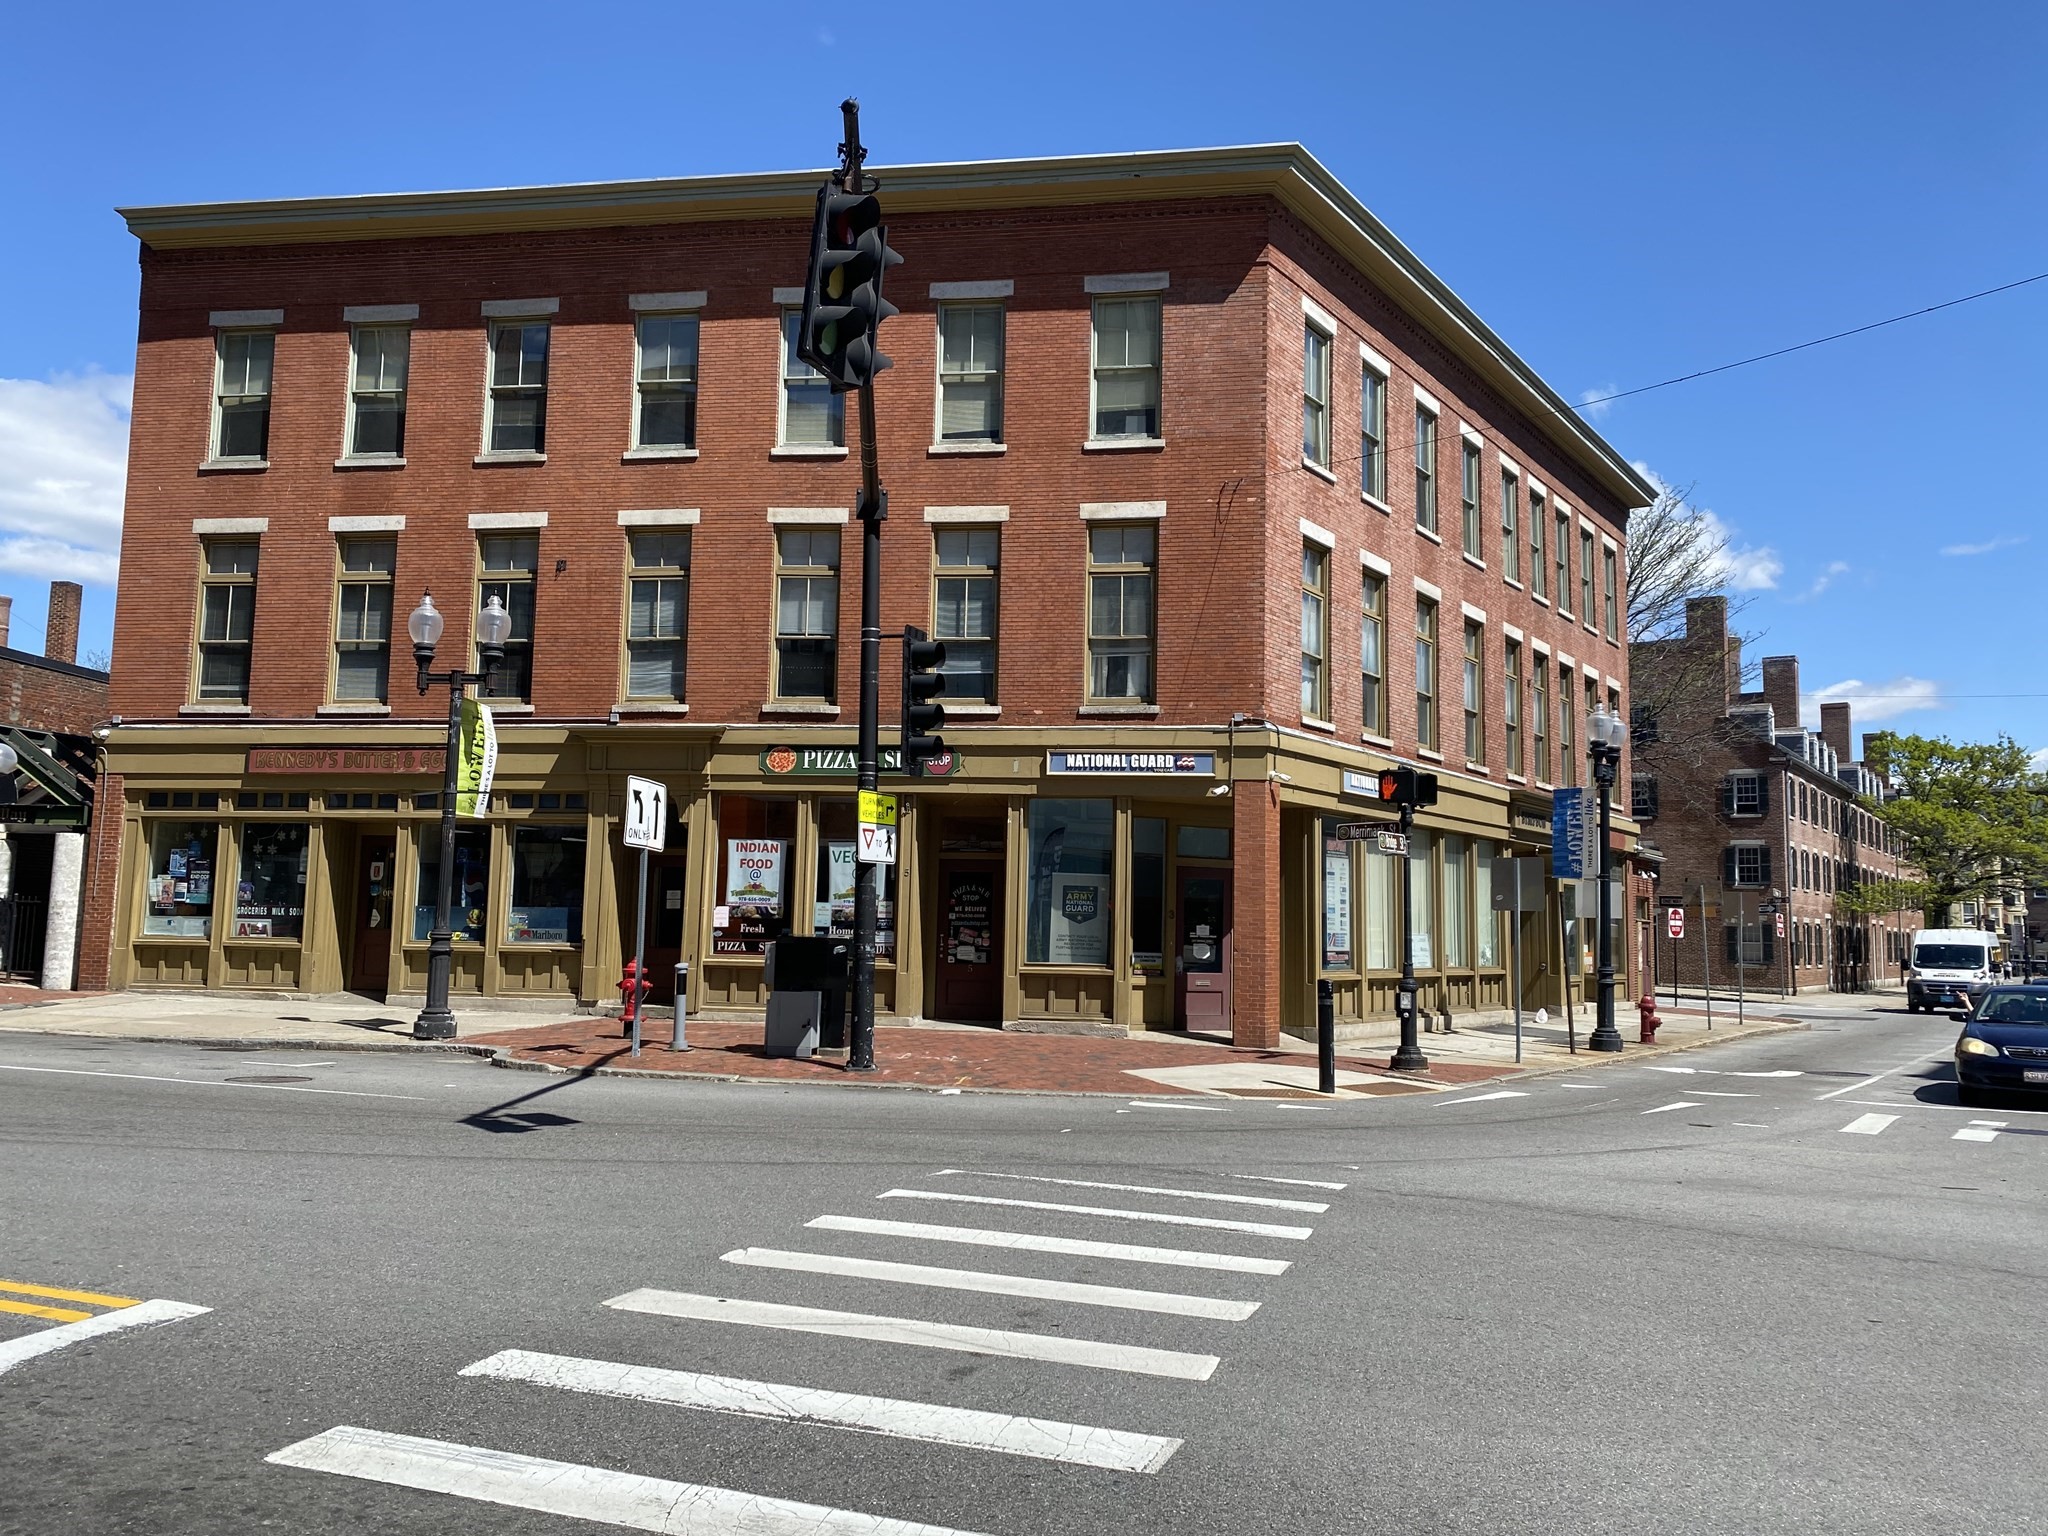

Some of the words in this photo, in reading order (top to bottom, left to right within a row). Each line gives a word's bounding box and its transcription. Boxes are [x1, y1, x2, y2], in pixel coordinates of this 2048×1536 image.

[255, 751, 338, 768] KENNEDY'S
[343, 751, 399, 769] BUTTER
[404, 751, 415, 769] &
[802, 749, 857, 769] PIZZA
[1066, 753, 1128, 769] NATIONAL
[1130, 754, 1174, 769] GUARD
[862, 796, 885, 808] TURNING
[862, 809, 885, 820] VEHICLES
[628, 827, 648, 840] ONLY
[736, 842, 779, 853] INDIAN
[876, 839, 883, 848] TO
[740, 858, 773, 869] FOOD
[749, 868, 762, 881] @
[237, 906, 268, 916] GROCERIES
[271, 907, 285, 916] MILK
[289, 907, 304, 916] SODA
[740, 923, 765, 934] Fresh
[531, 930, 563, 940] Marlboro
[717, 941, 747, 952] PIZZA
